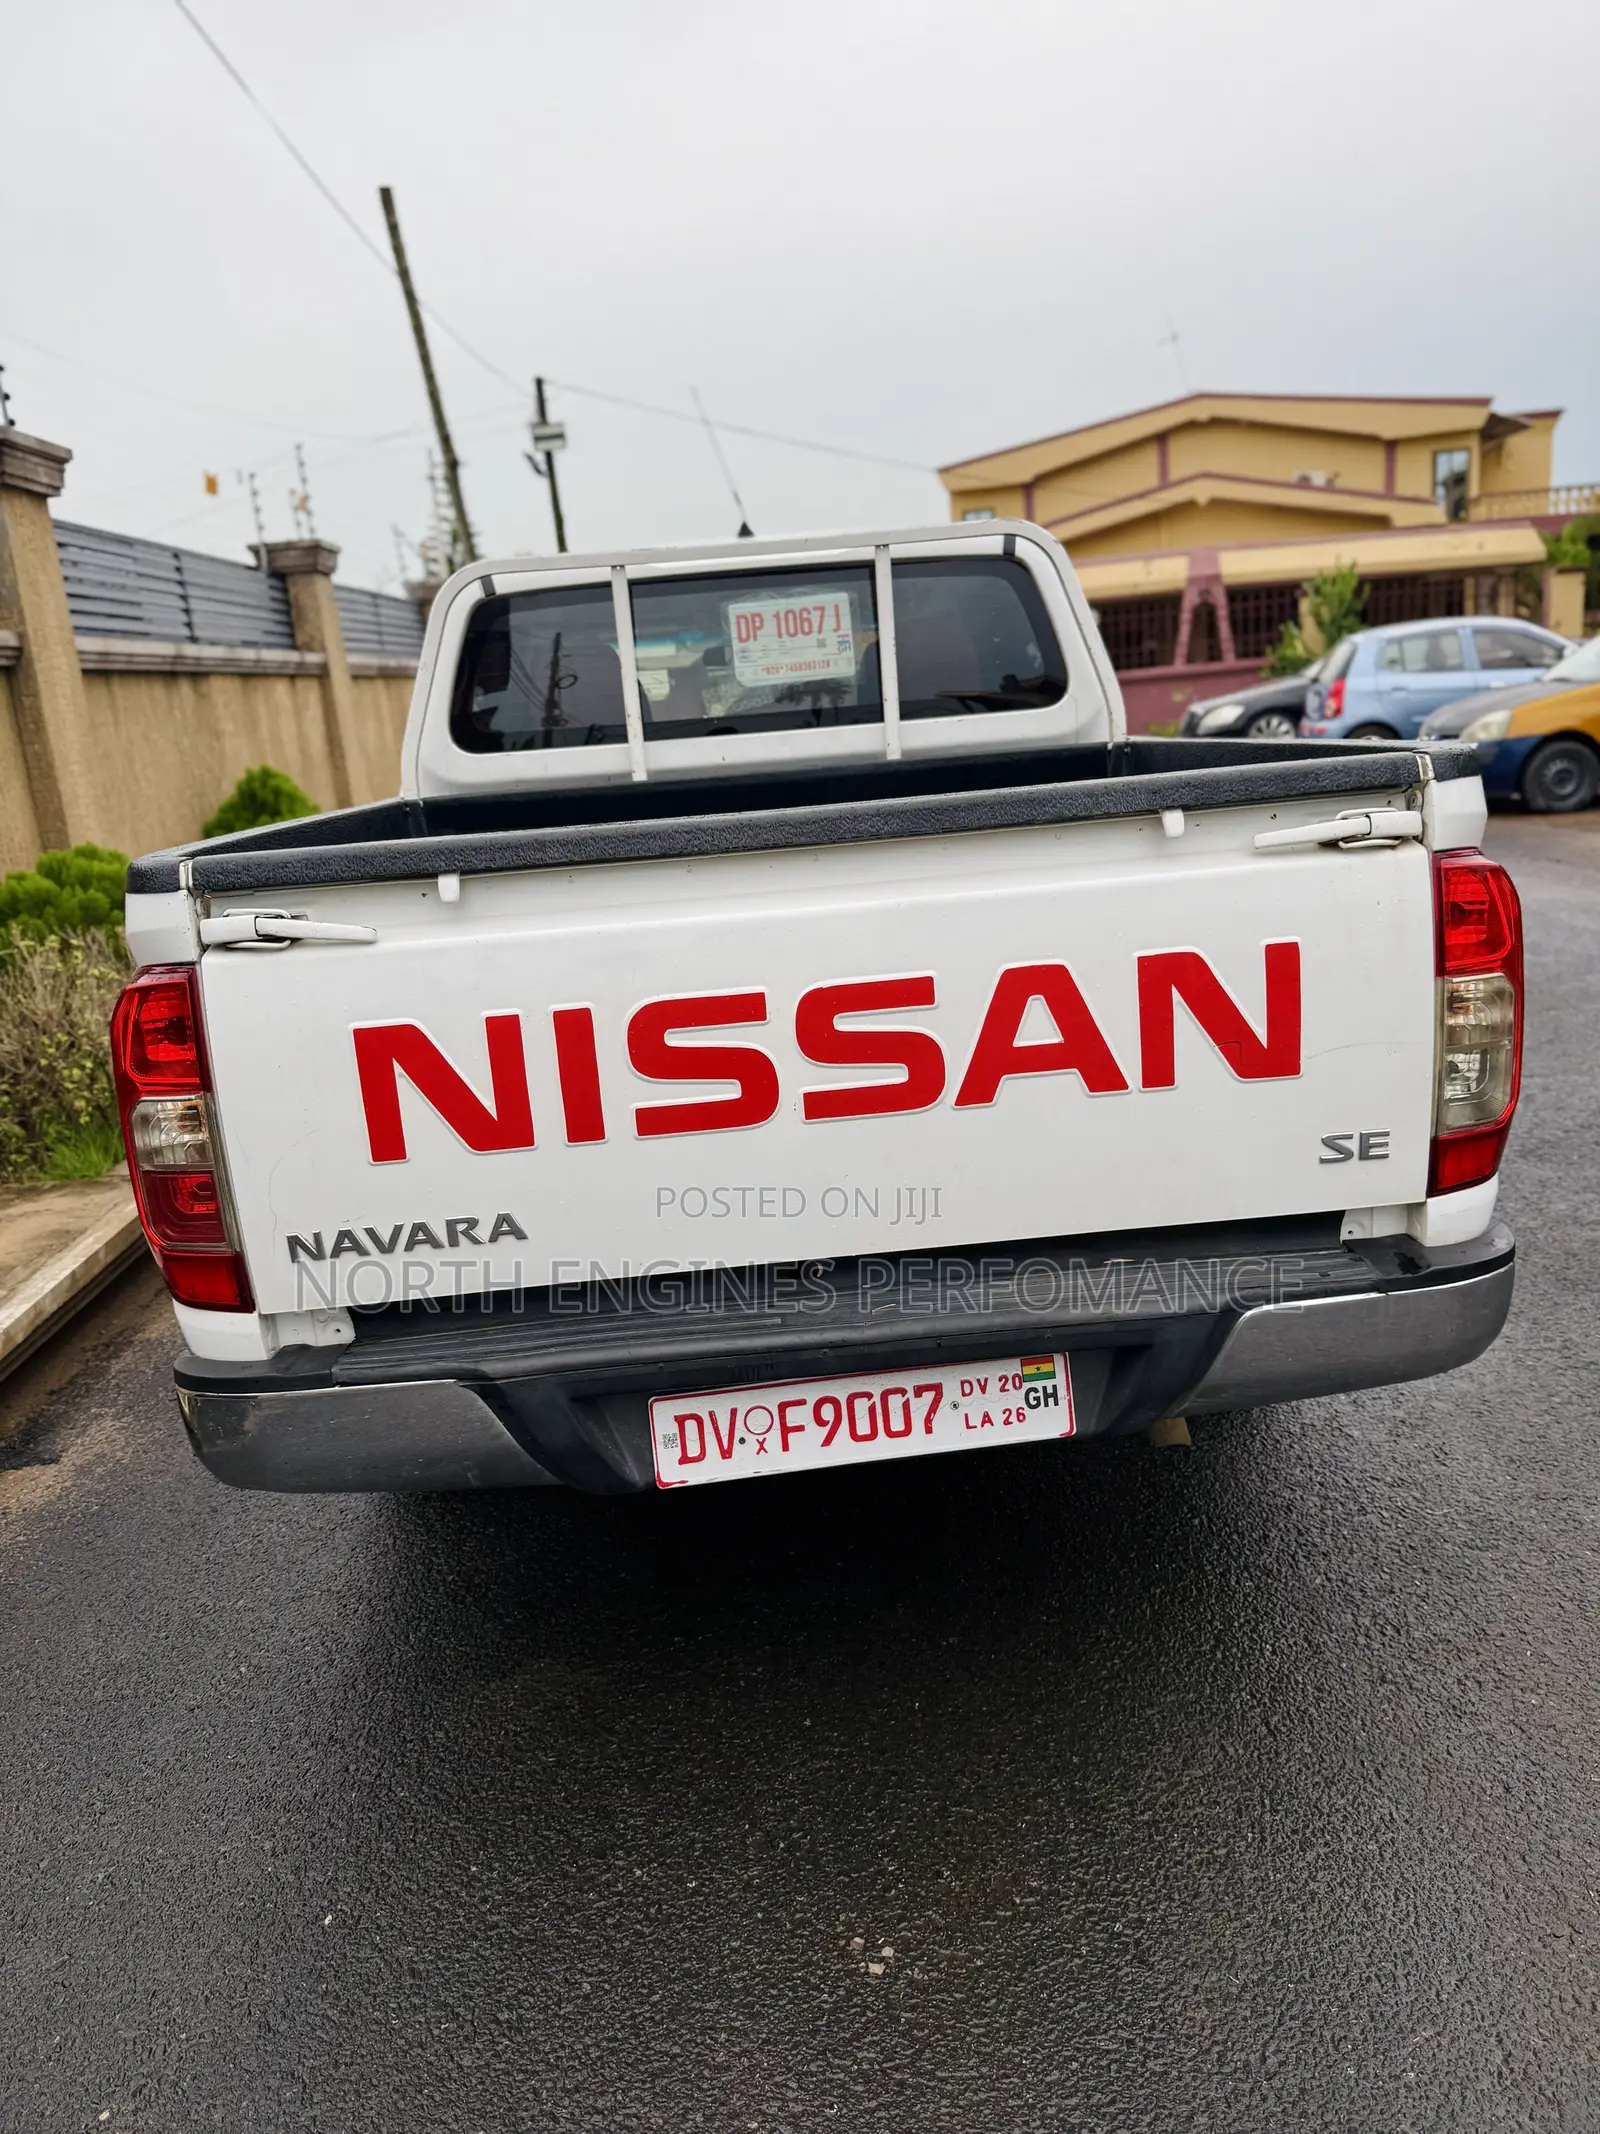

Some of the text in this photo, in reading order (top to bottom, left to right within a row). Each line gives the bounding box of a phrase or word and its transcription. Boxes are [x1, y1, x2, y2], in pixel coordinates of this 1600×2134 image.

[735, 603, 841, 643] DP 1067 J
[349, 936, 1303, 1164] NISSAN
[1319, 1128, 1391, 1164] SE
[286, 1211, 528, 1263] NAVARA
[960, 1372, 1023, 1398] DV 20
[1024, 1383, 1060, 1408] GH
[674, 1381, 944, 1465] DV F9007
[965, 1406, 1027, 1430] LA 26
